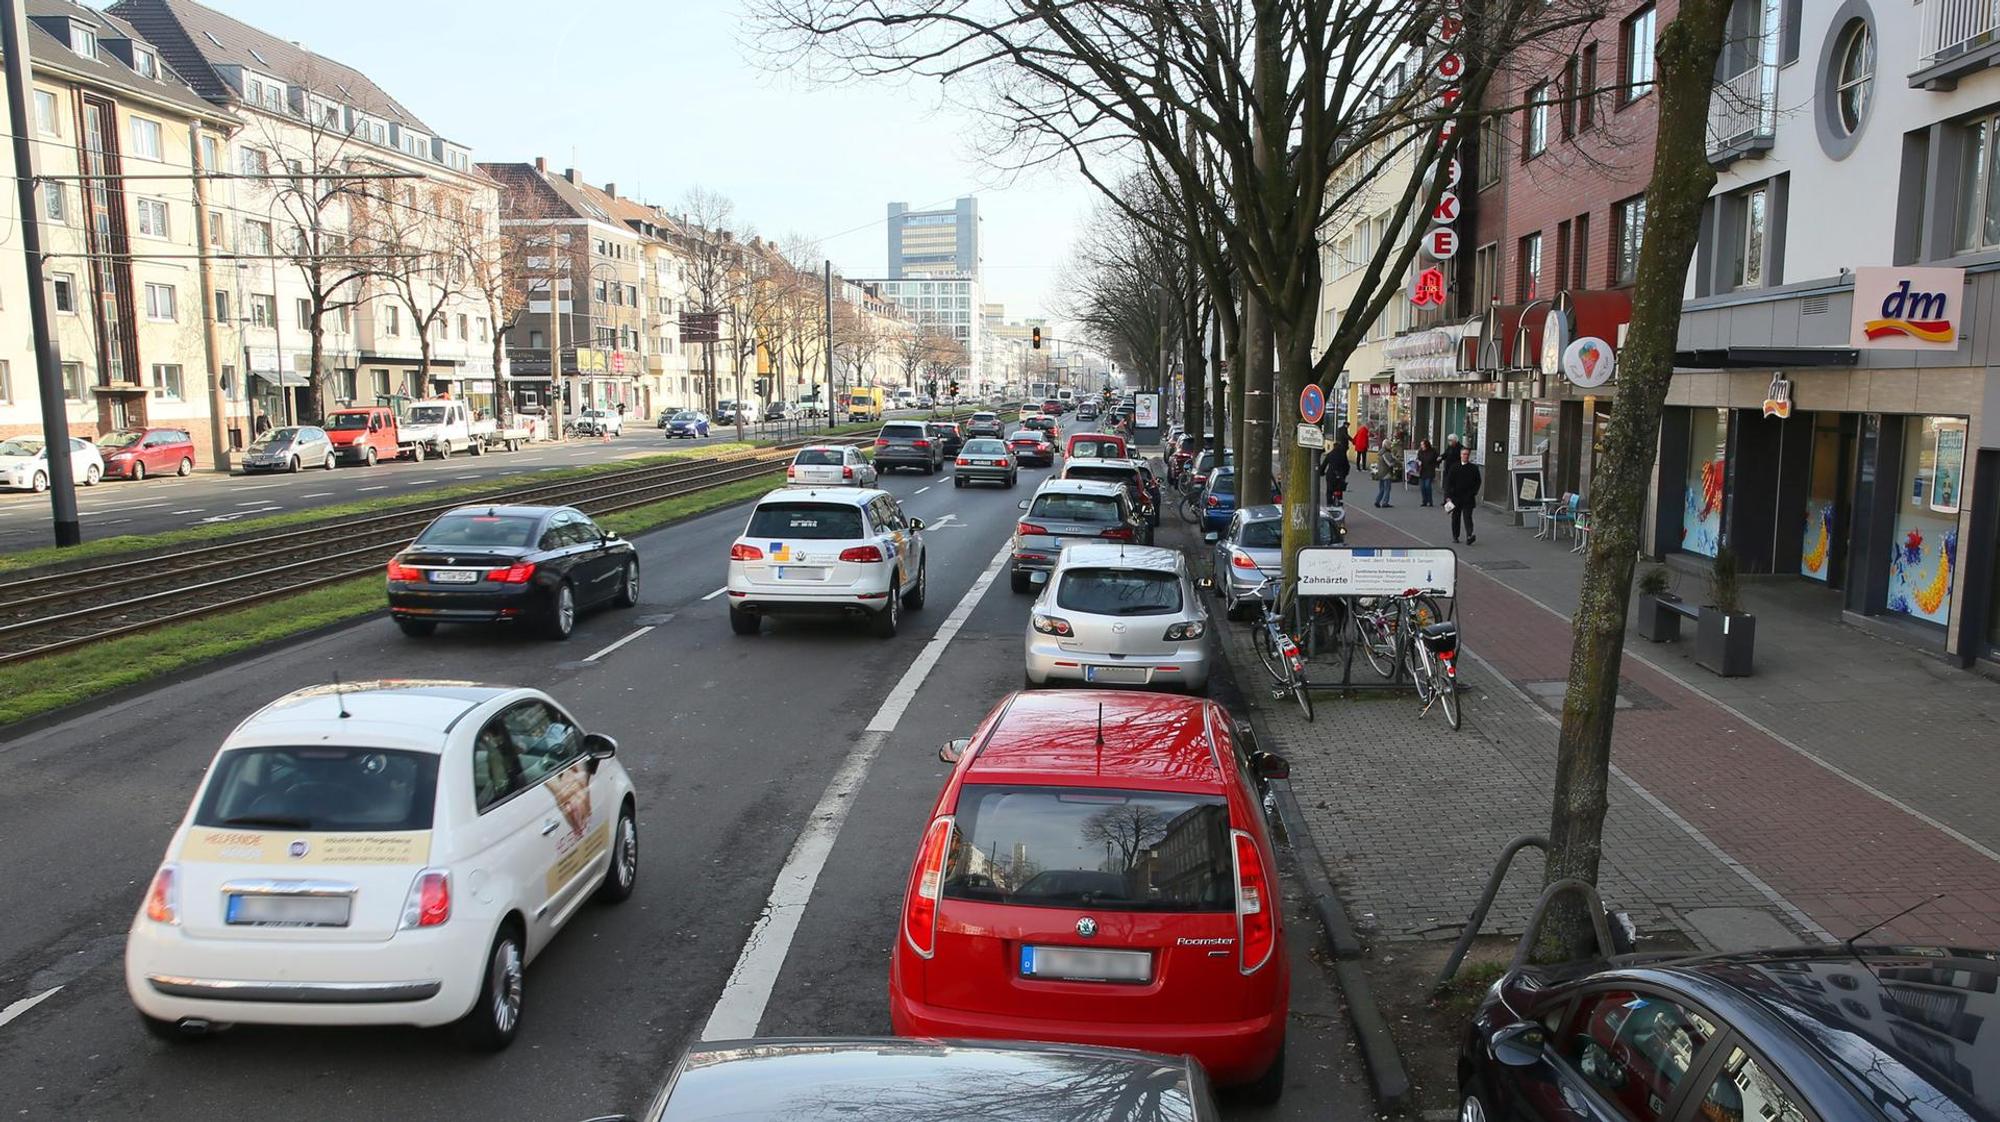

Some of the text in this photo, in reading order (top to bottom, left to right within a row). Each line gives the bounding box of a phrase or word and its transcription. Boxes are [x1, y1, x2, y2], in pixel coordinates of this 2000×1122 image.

[1881, 280, 1947, 320] dm
[1769, 373, 1788, 401] dm
[1303, 575, 1349, 584] Zahnärzte
[1176, 937, 1235, 946] Roomster
